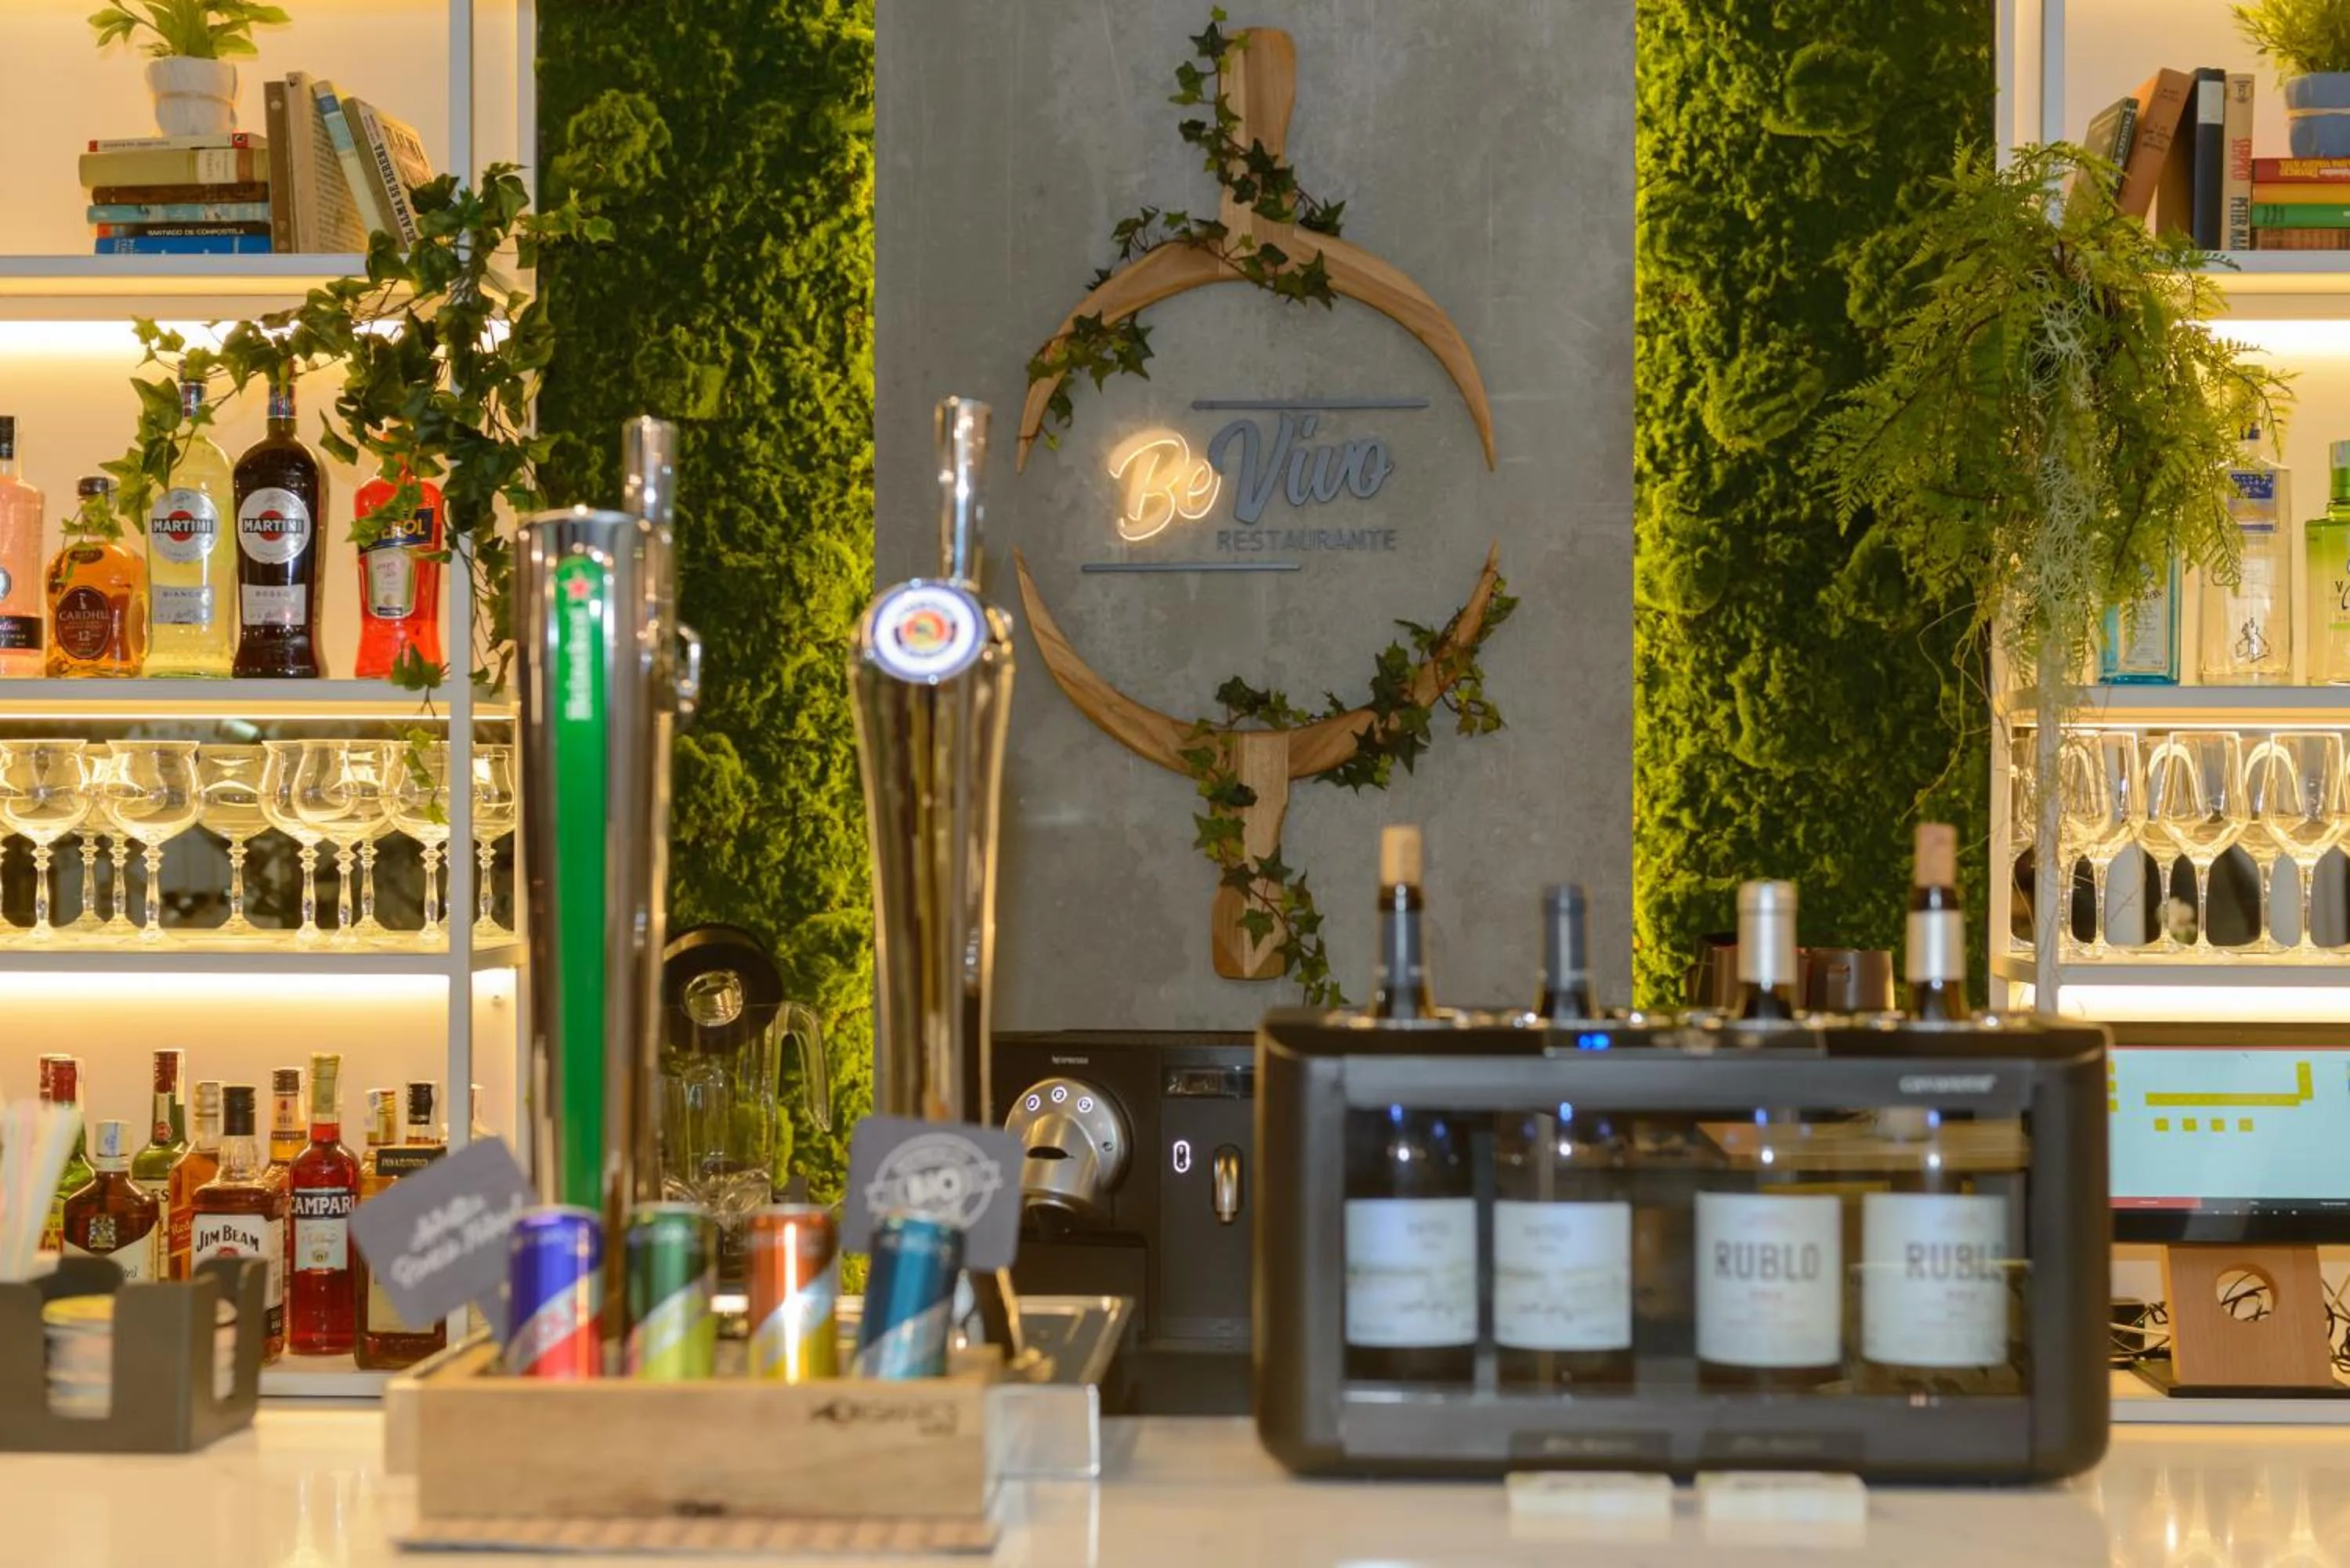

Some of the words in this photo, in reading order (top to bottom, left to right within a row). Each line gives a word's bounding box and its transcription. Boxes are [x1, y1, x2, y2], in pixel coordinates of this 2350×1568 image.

[374, 143, 396, 184] SERENA
[1108, 427, 1221, 541] Be
[1207, 410, 1395, 526] Vivo
[153, 519, 212, 533] MARTINI
[244, 519, 302, 533] MARTINI
[1217, 529, 1397, 551] RESTAURANTE
[78, 630, 91, 641] 12
[196, 1230, 220, 1252] JIM
[222, 1224, 259, 1252] BEAM
